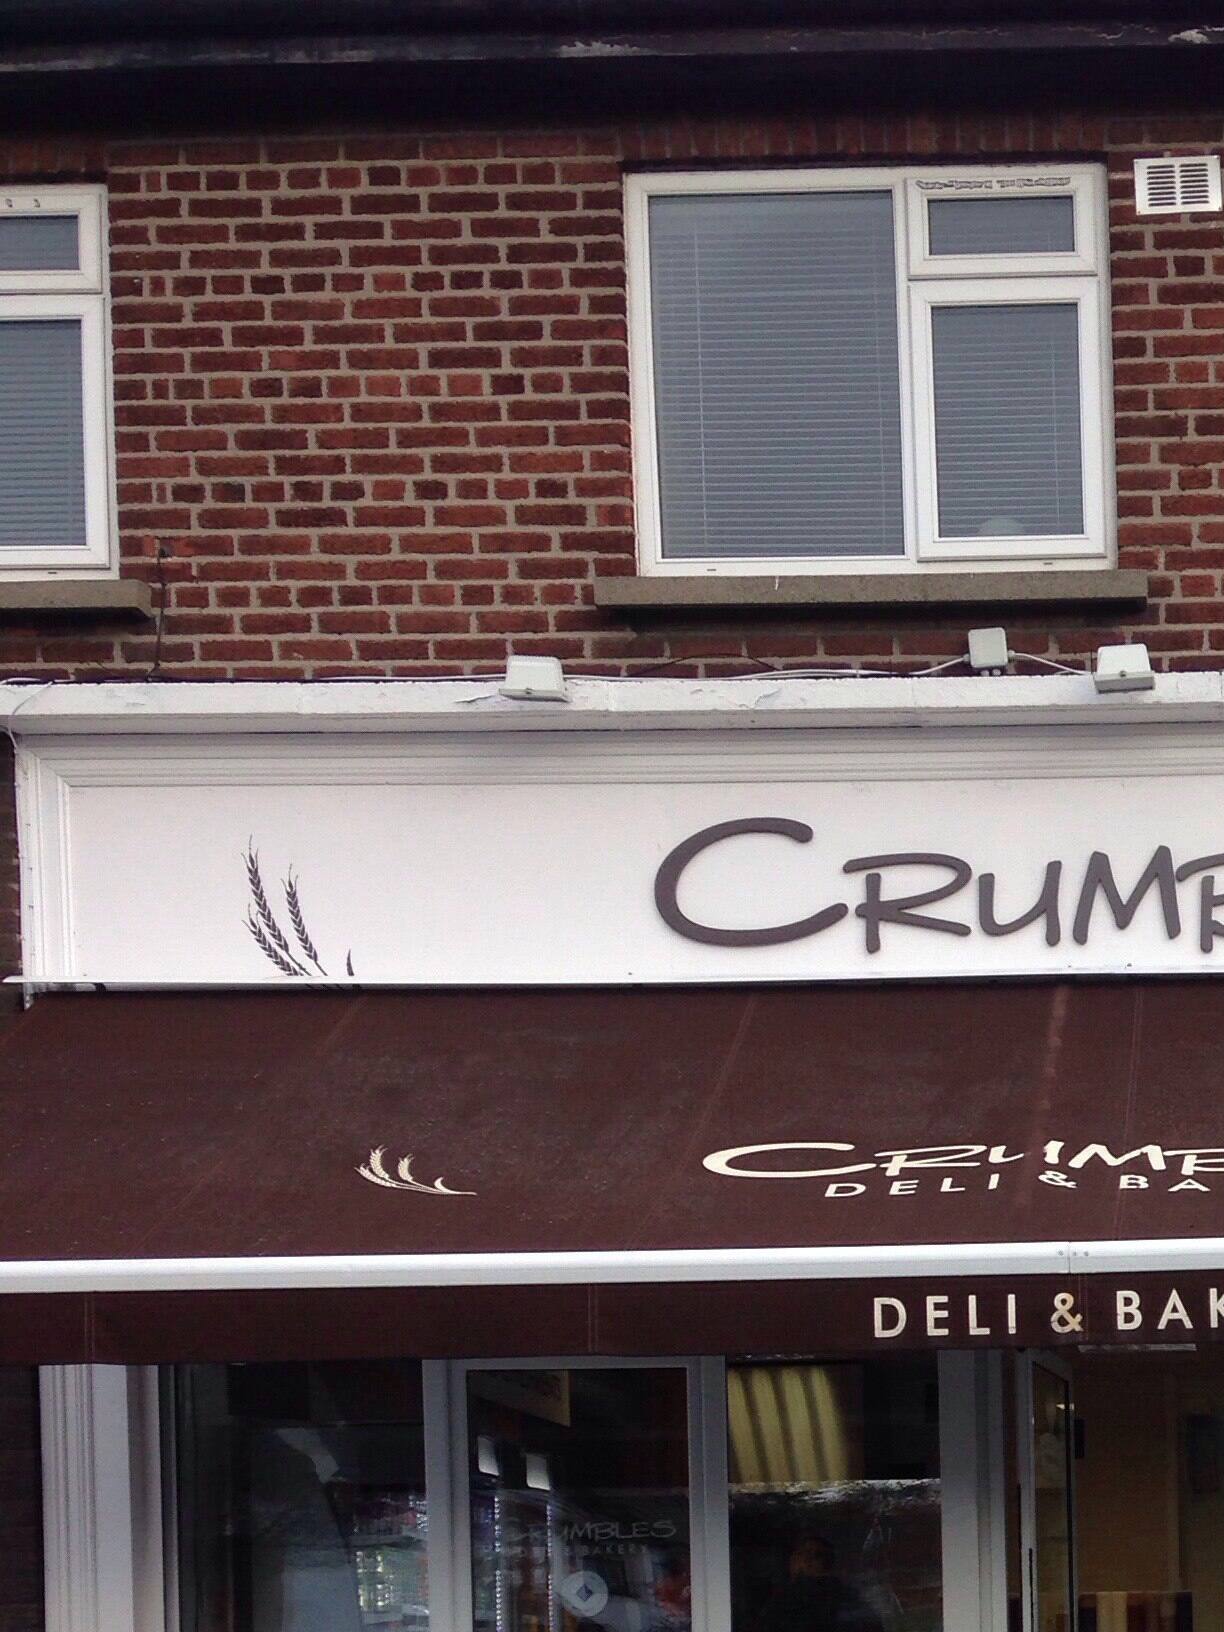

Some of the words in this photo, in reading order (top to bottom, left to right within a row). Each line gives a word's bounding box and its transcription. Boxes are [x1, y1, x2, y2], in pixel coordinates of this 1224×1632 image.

[823, 1173, 1001, 1198] DELI
[1037, 1169, 1078, 1189] &
[872, 1293, 1018, 1339] DELI
[1049, 1291, 1084, 1334] &
